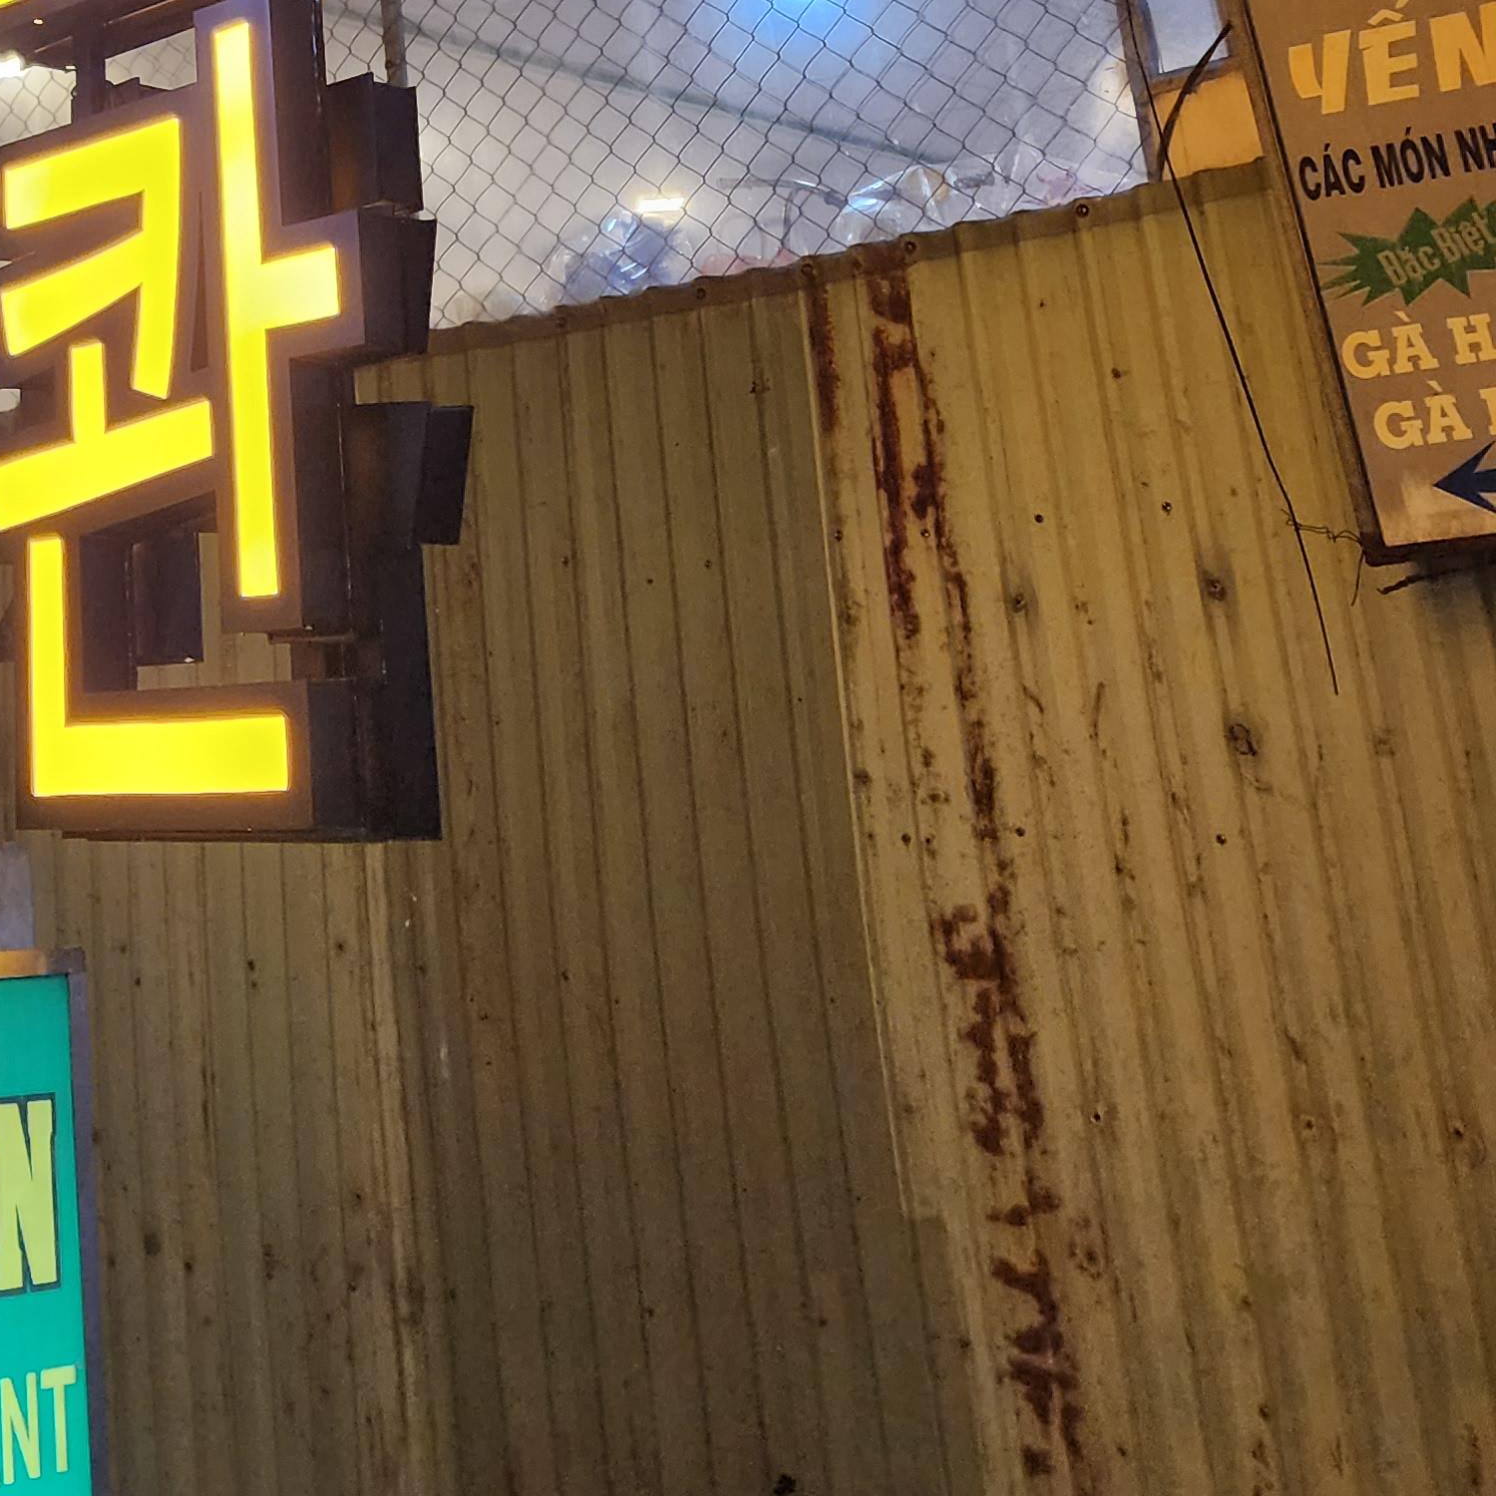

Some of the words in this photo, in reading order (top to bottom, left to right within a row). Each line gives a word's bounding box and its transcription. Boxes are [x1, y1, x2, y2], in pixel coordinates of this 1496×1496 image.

[1299, 143, 1365, 201] CÁC
[1370, 127, 1451, 188] MÓN
[1342, 311, 1440, 379] GÀ
[1374, 380, 1473, 450] GÀ
